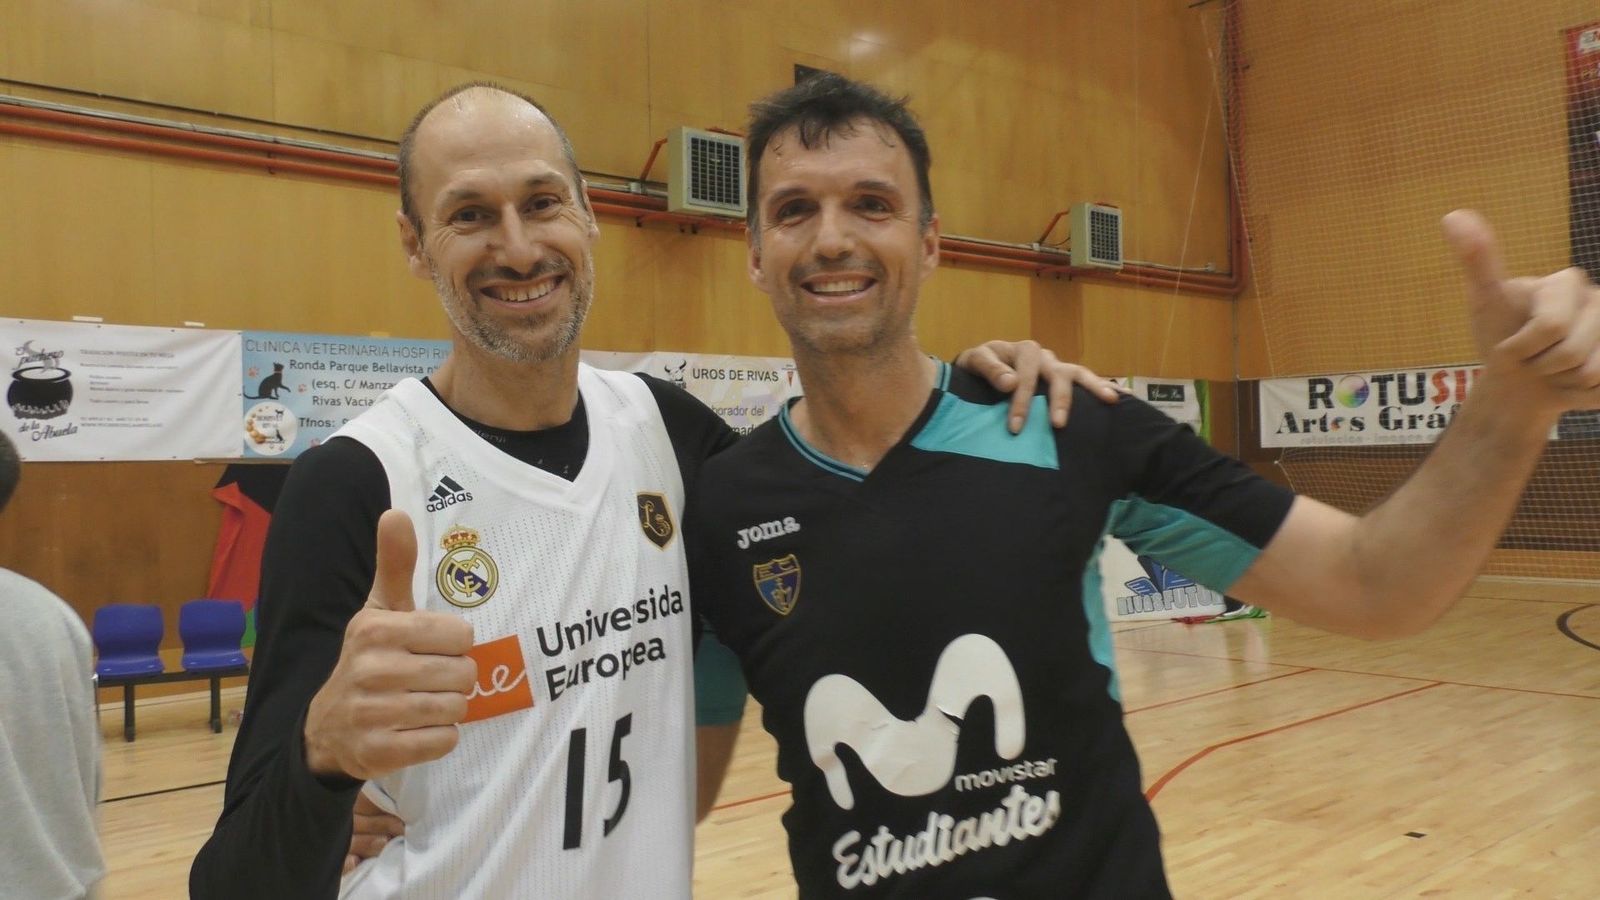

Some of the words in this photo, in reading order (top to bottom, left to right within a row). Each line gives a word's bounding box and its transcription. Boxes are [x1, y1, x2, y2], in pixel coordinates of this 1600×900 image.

[246, 339, 300, 354] CLINICA
[304, 342, 389, 357] VETERINARIA
[290, 360, 326, 371] Ronda
[330, 361, 369, 373] Parque
[372, 362, 424, 374] Bellavista
[692, 368, 726, 381] UROS
[729, 369, 744, 381] DE
[747, 370, 779, 382] RIVAS
[312, 396, 341, 406] Rivas
[751, 406, 765, 417] del
[1276, 411, 1365, 434] Artes
[426, 489, 473, 513] adidas
[546, 637, 666, 701] Europea
[563, 712, 632, 850] 15
[954, 757, 1058, 792] movistar
